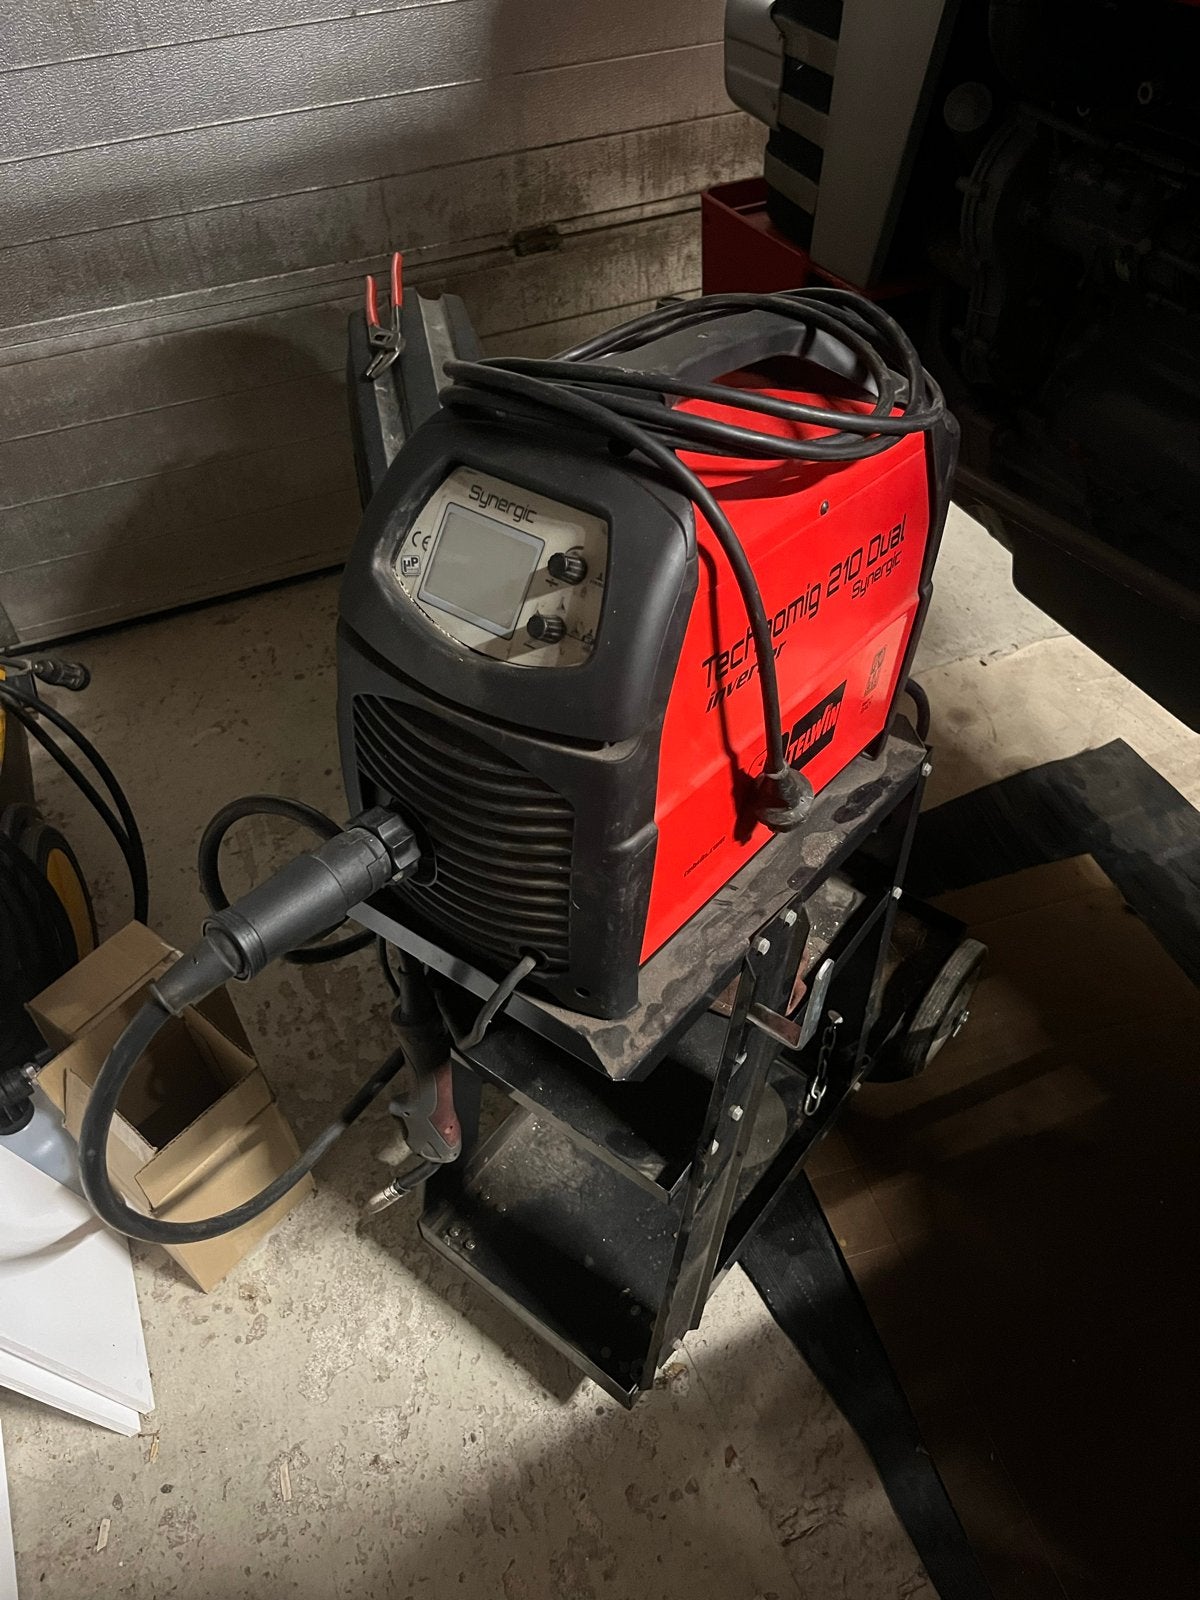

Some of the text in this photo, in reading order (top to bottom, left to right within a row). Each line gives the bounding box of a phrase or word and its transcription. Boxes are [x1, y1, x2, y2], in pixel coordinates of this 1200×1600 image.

[469, 484, 537, 523] Synergic
[826, 547, 863, 598] 210
[866, 513, 906, 568] Dual
[852, 550, 902, 599] Synergic
[706, 640, 786, 713] inverr
